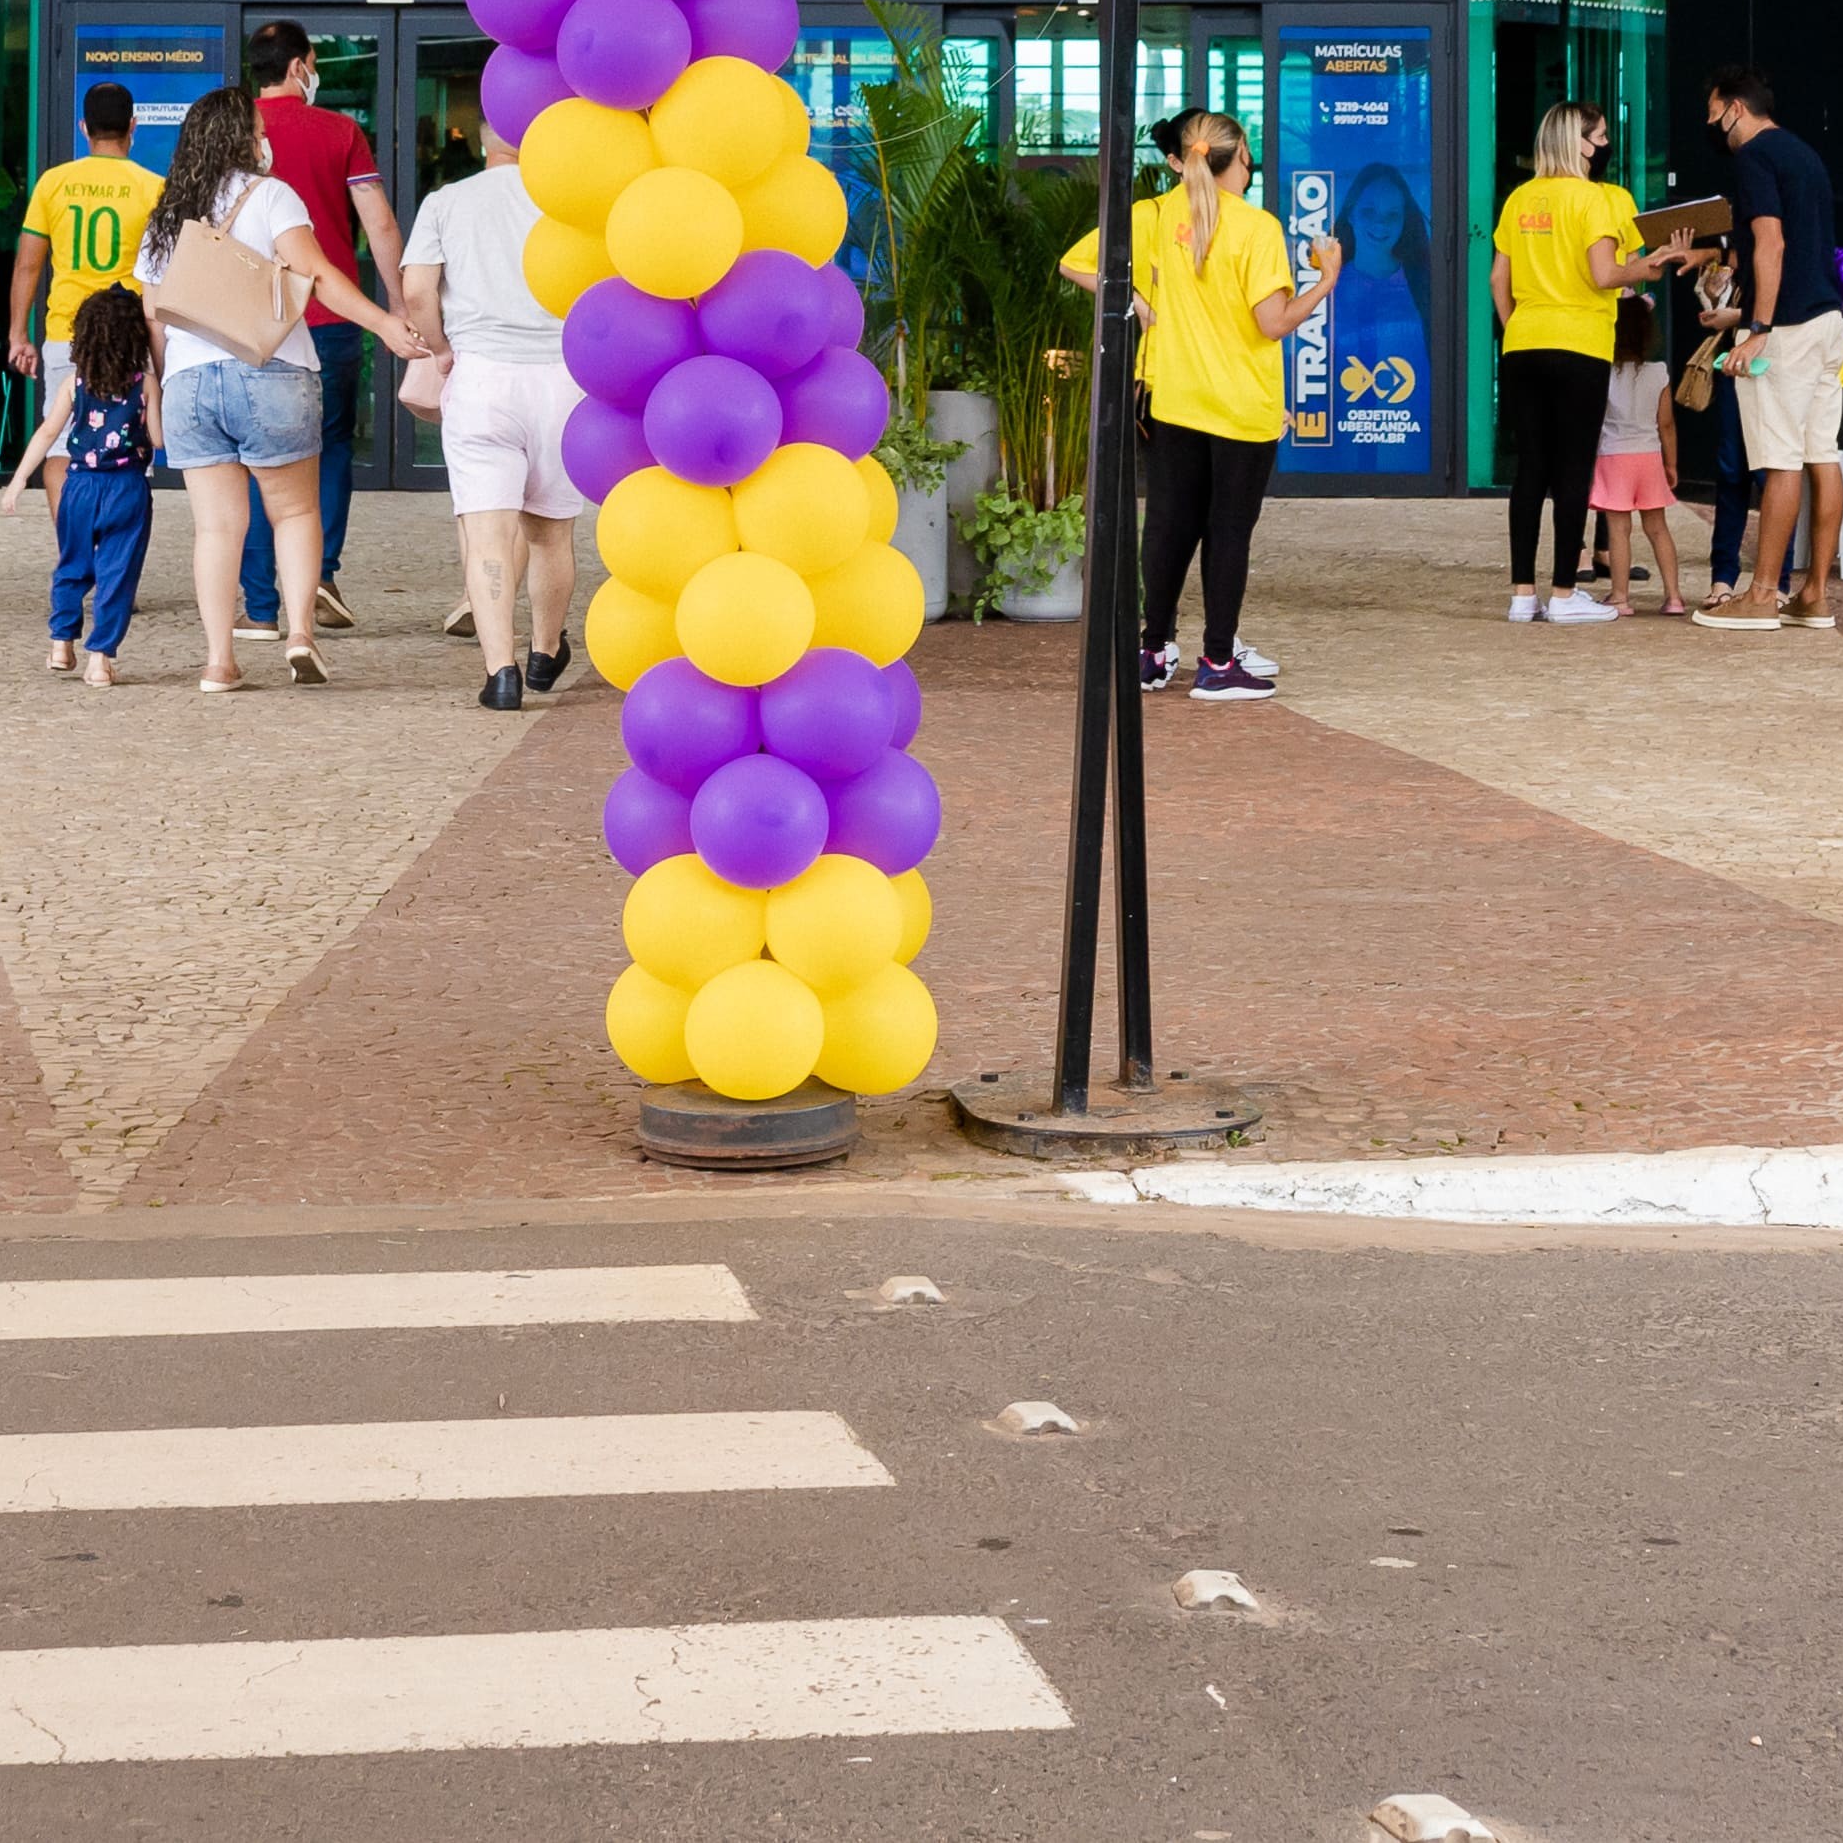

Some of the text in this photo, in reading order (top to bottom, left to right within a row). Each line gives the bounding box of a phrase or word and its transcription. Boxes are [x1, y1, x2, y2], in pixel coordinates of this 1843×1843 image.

[85, 49, 204, 62] NOVO ENSINO MÉDIO
[1315, 43, 1402, 58] MATRÍCULAS
[1325, 60, 1388, 73] ABERTAS
[136, 104, 186, 112] ESTRUTURA
[1334, 102, 1389, 112] 3219-4041
[147, 115, 183, 124] FORMAÇ
[1333, 115, 1389, 125] 99107-1323
[64, 183, 132, 199] NEYMAR JR
[68, 205, 121, 272] 10
[1347, 409, 1411, 421] OBJETIVO
[1296, 411, 1327, 438] E
[1338, 421, 1421, 432] UBERLANDIA
[1352, 433, 1406, 444] .COM.BR
